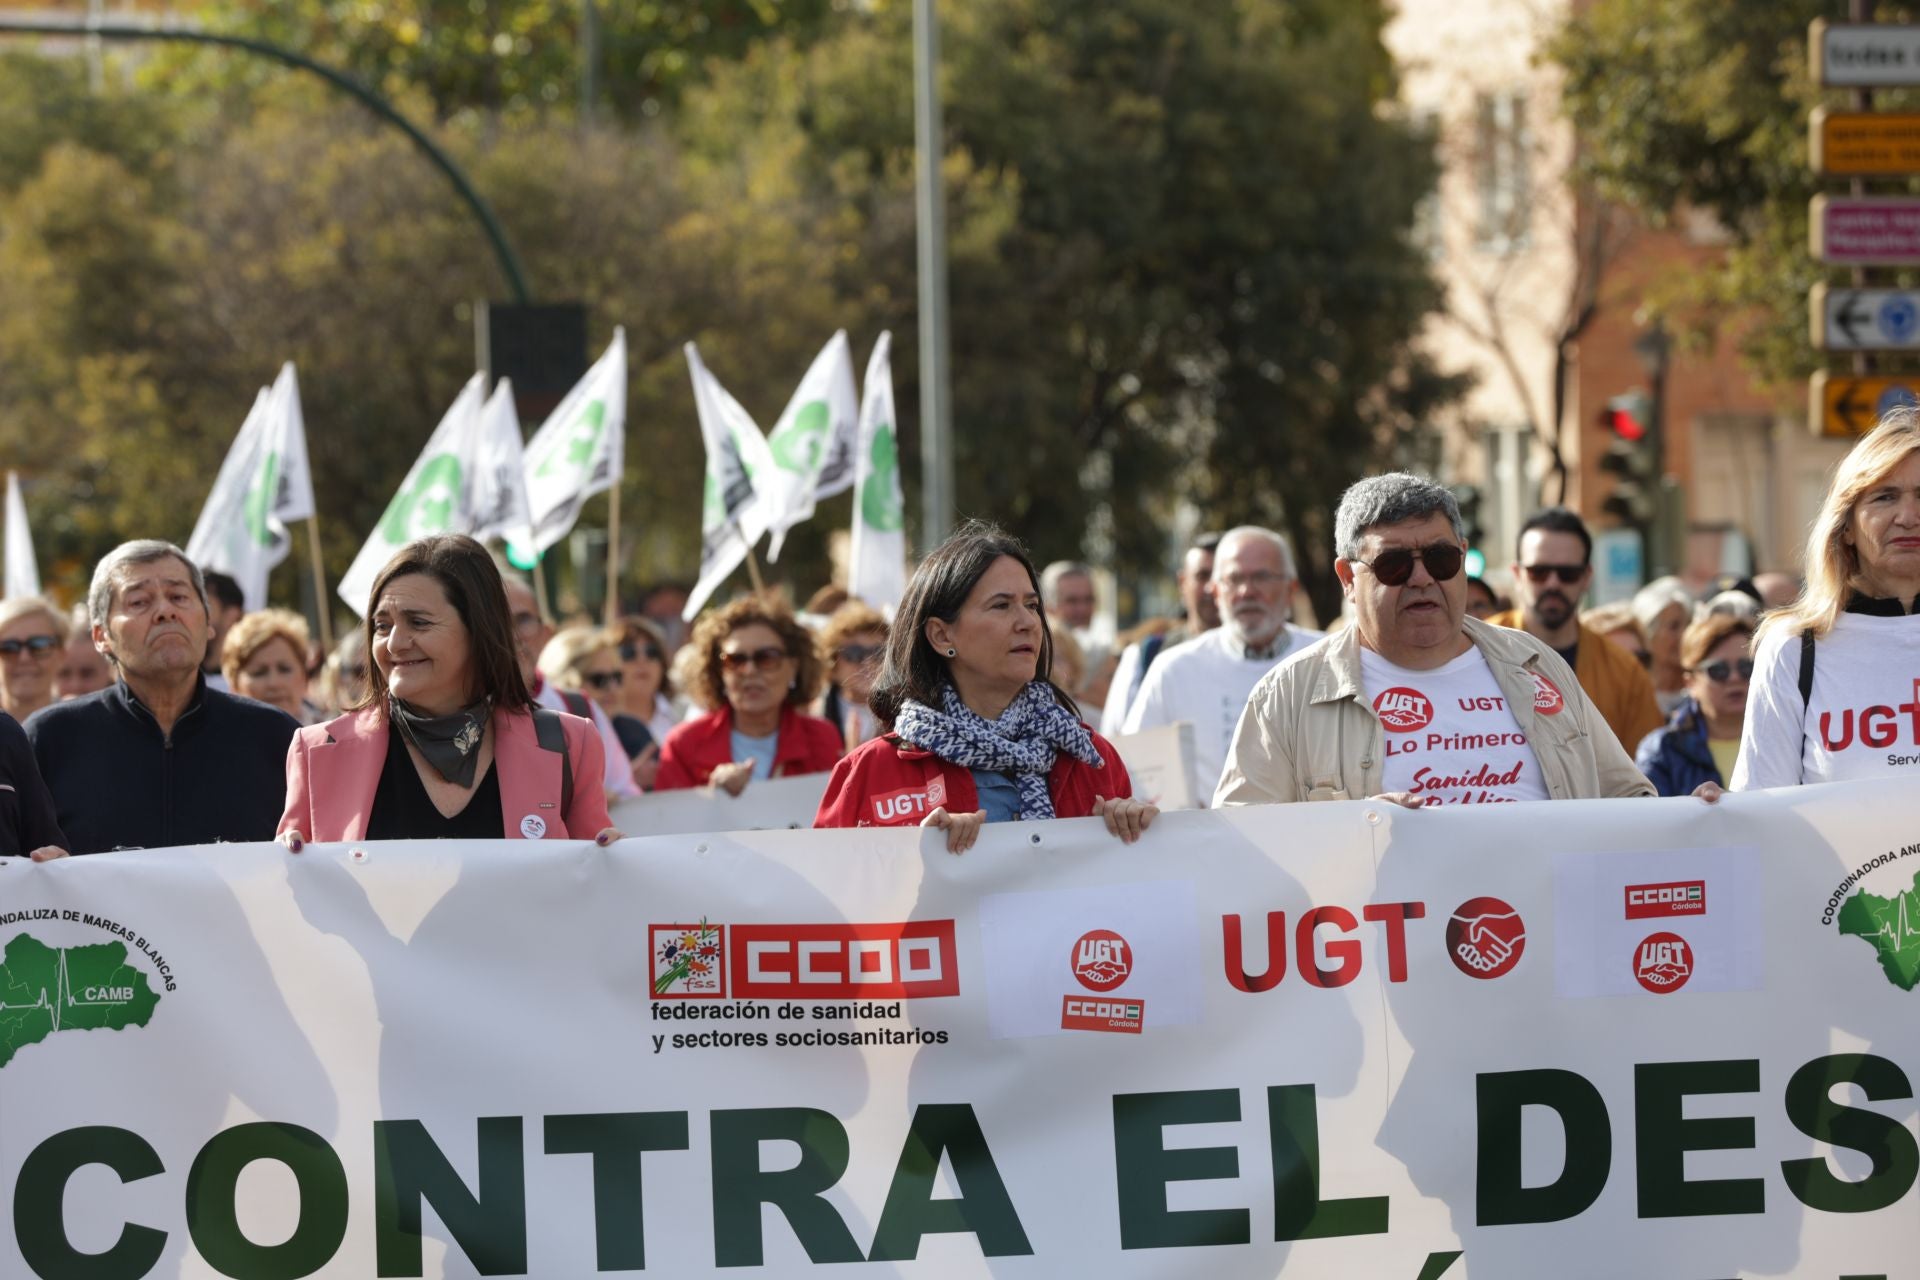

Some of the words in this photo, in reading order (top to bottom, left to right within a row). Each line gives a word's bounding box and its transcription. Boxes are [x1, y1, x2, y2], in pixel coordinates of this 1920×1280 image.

[1380, 692, 1427, 715] UGT
[1458, 697, 1503, 712] UGT
[1819, 704, 1920, 752] UGT
[1386, 740, 1417, 757] Lo
[1427, 732, 1526, 751] Primero
[1408, 760, 1523, 794] Sanidad
[875, 793, 926, 820] UGT
[1629, 887, 1687, 905] CCOO
[1821, 851, 1897, 926] COORDINADORA
[1671, 902, 1702, 911] Córdoba
[62, 910, 80, 922] DE
[83, 914, 136, 942] MAREAS
[135, 937, 177, 992] BLANCAS
[747, 936, 943, 984] CCOO
[1079, 940, 1124, 965] UGT
[1222, 902, 1425, 993] UGT
[1640, 942, 1685, 968] UGT
[85, 987, 134, 1000] CAMB
[650, 1000, 770, 1020] federación
[777, 1002, 805, 1019] de
[812, 1002, 900, 1019] sanidad
[1066, 1001, 1126, 1019] CCOO
[1108, 1019, 1139, 1028] Córdoba
[652, 1034, 665, 1053] y
[672, 1031, 768, 1048] sectores
[775, 1027, 949, 1047] sociosanitarios
[14, 1104, 1034, 1280] CONTRA
[1113, 1082, 1389, 1249] EL
[1476, 1054, 1920, 1226] DES
